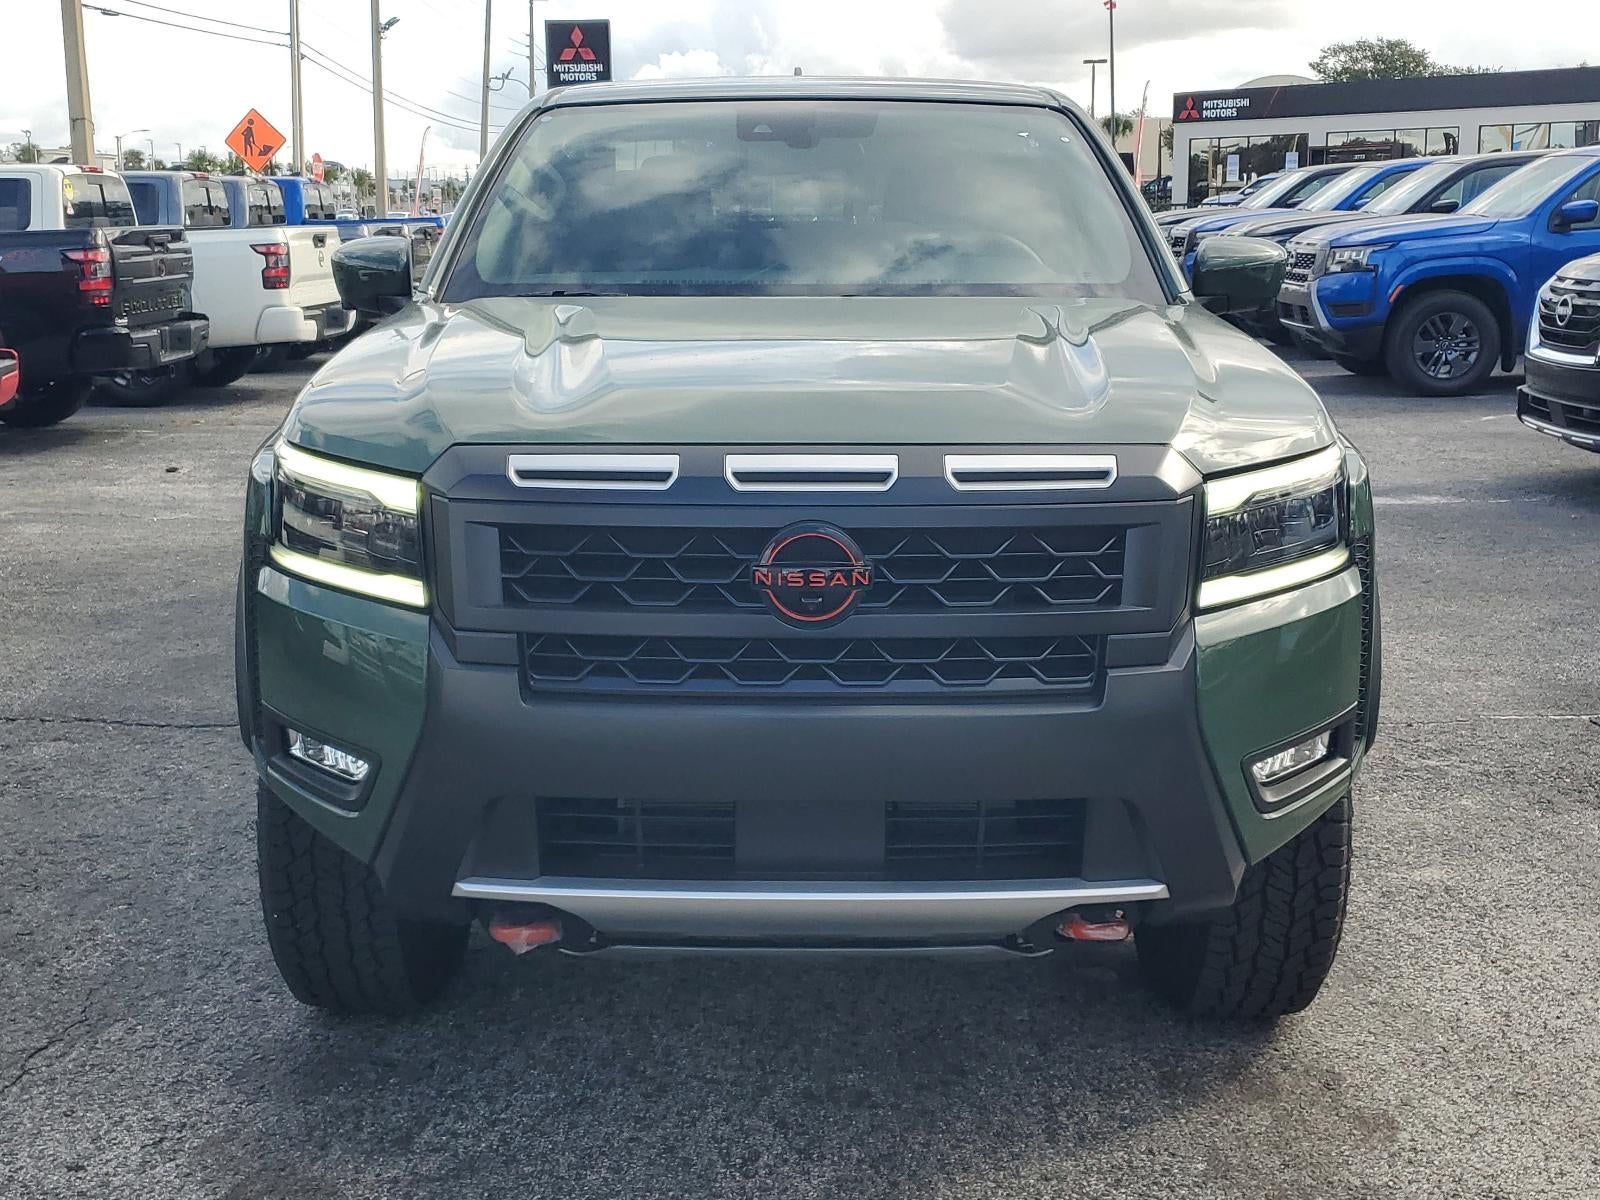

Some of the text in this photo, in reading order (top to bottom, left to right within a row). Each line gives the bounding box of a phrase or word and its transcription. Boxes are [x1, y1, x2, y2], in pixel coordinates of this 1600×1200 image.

[553, 63, 604, 72] MITSUBISHI
[560, 72, 597, 81] MOTORS
[1202, 98, 1250, 109] MITSUBISHI
[1202, 108, 1238, 118] MOTORS
[753, 570, 870, 587] NISSAN
